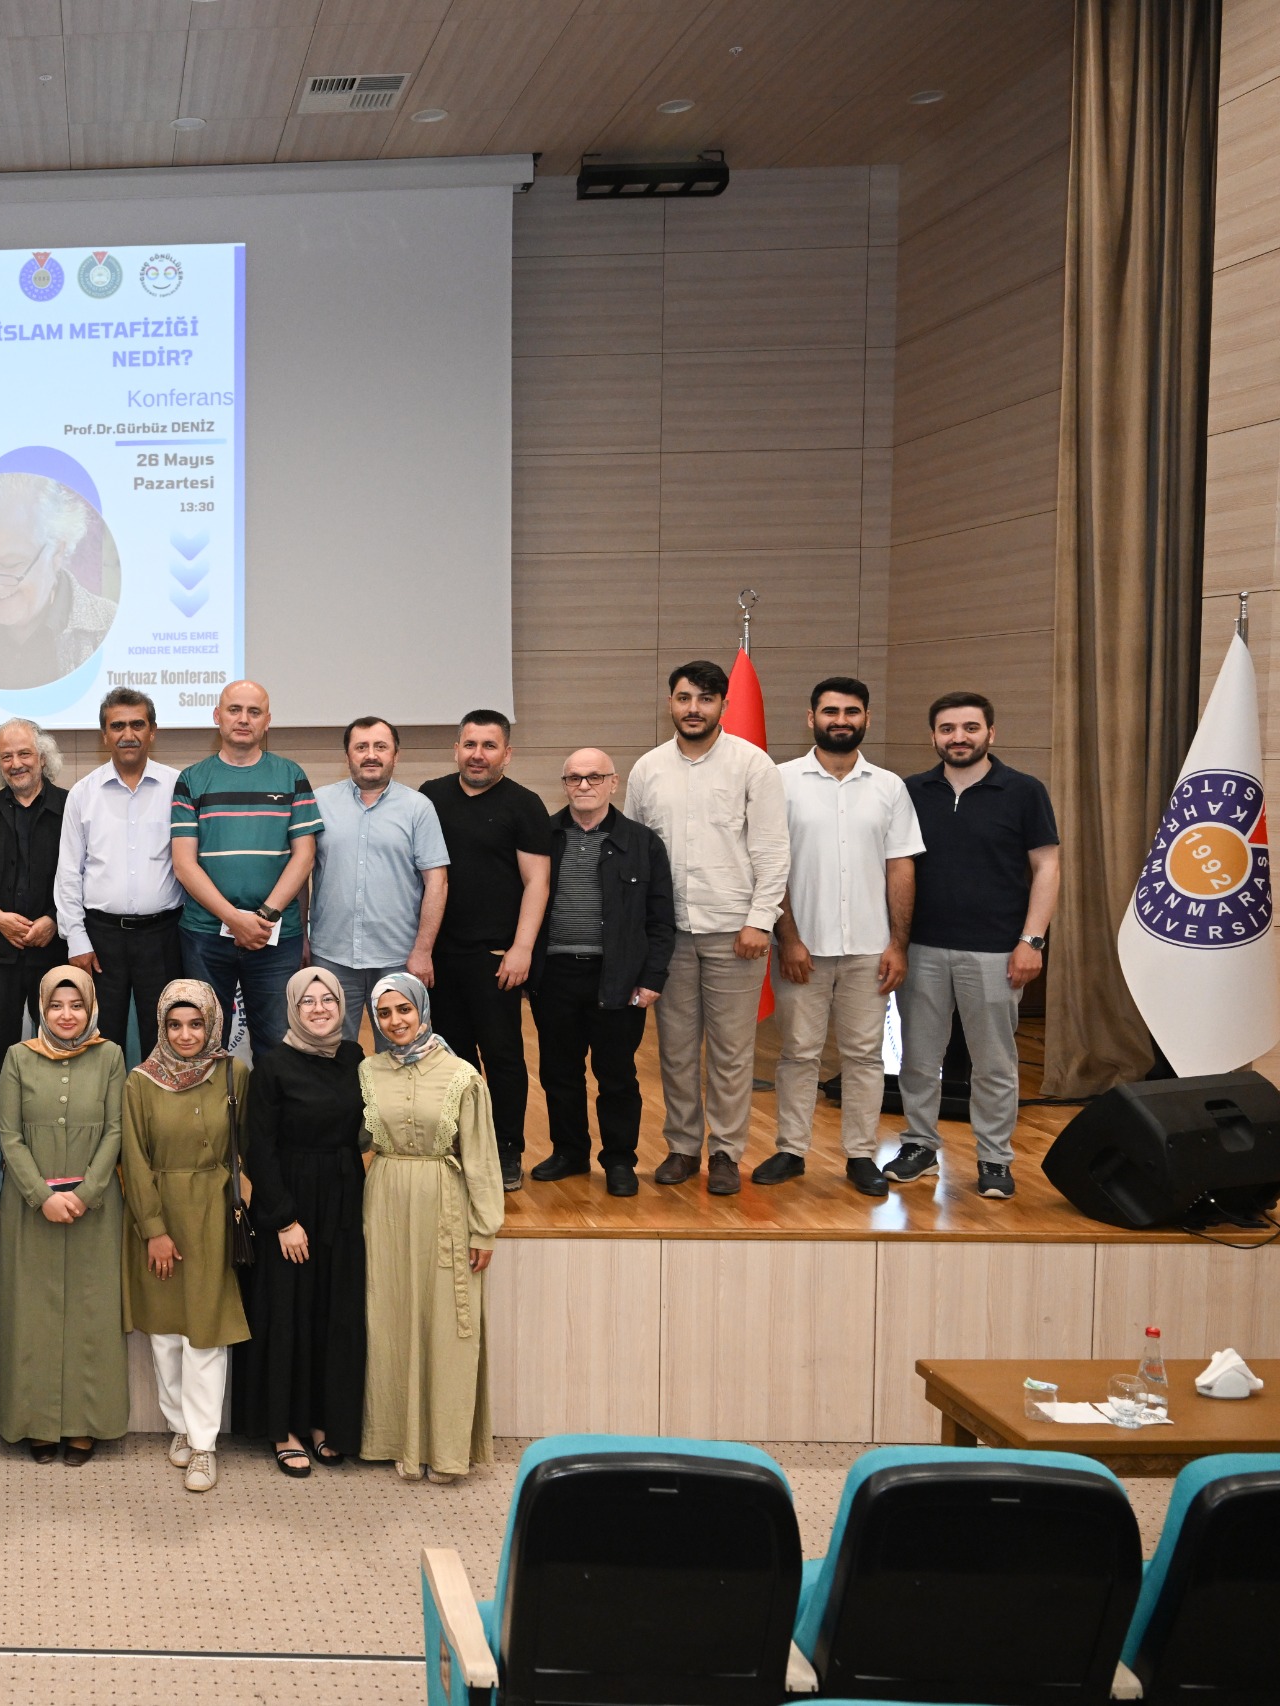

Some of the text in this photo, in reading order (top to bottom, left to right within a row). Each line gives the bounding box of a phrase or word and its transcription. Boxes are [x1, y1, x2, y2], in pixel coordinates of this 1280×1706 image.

[69, 316, 199, 340] METAFİZİĞİ
[112, 346, 193, 367] NEDİR?
[127, 388, 234, 408] Konferans
[64, 418, 215, 436] Prof.Dr.Gürbüz DENİZ
[136, 453, 215, 469] 26 Mayıs
[133, 476, 215, 491] Pazartesi
[179, 501, 215, 513] 13:30
[152, 631, 219, 641] YUNUS EMRE
[128, 644, 219, 655] KONGRE MERKEZİ
[107, 669, 227, 686] Turkuaz Konferans
[1184, 831, 1232, 890] 1992
